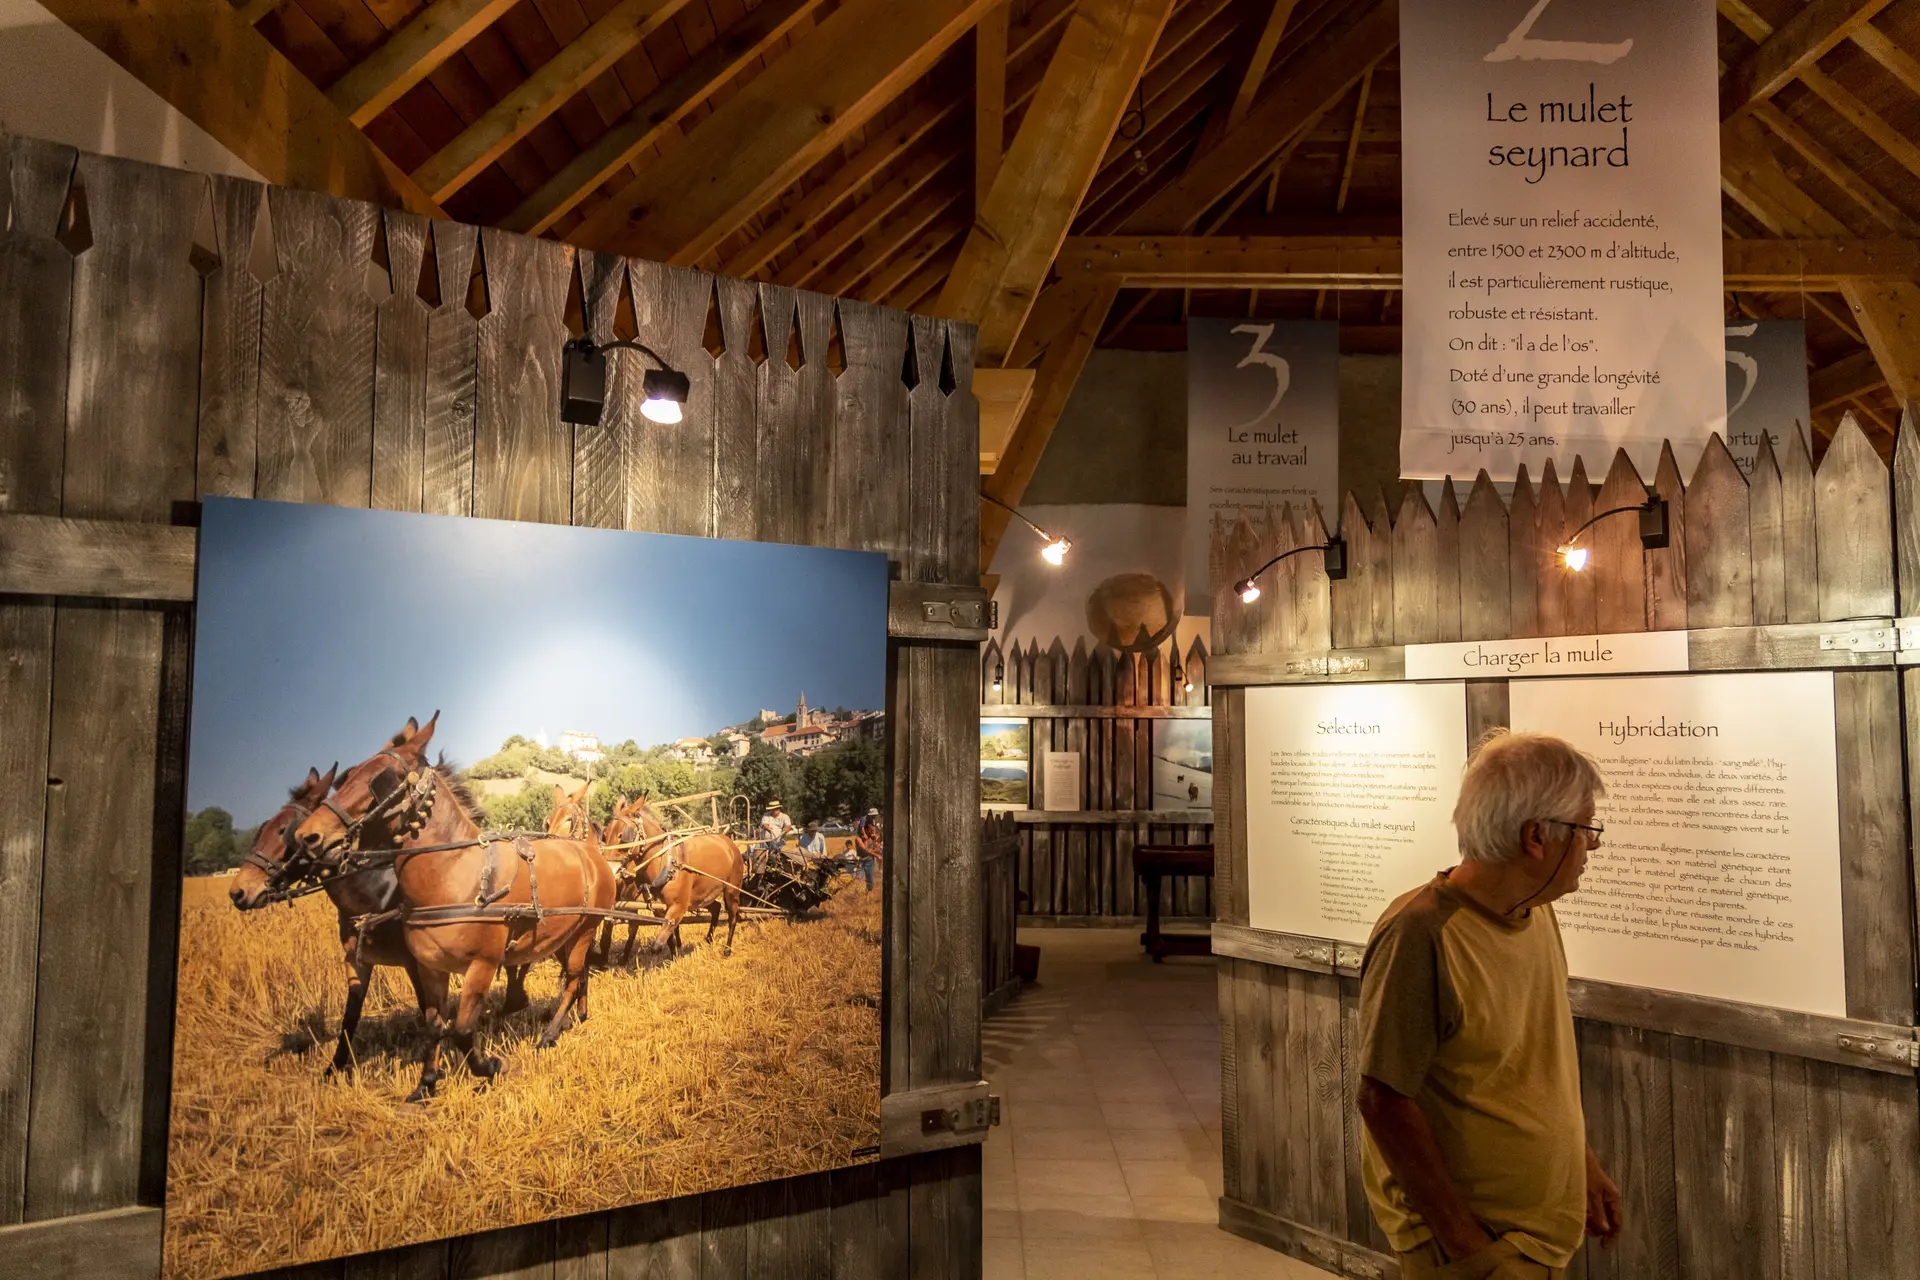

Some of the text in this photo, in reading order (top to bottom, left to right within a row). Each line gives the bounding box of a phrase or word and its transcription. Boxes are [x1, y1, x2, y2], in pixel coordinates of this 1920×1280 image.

[1487, 83, 1633, 123] Le mulet
[1488, 127, 1629, 184] seynard
[1448, 209, 1659, 230] Elevé sur un relief accidenté,
[1448, 245, 1487, 257] entre
[1491, 244, 1524, 258] 1500
[1529, 247, 1543, 258] et
[1548, 245, 1586, 259] 2300
[1591, 248, 1602, 258] m
[1448, 270, 1673, 297] il est particulièrement rustique,
[1448, 301, 1598, 321] robuste et résistant.
[1449, 337, 1473, 351] On
[1478, 333, 1498, 351] dit
[1527, 341, 1535, 350] a
[1540, 334, 1558, 352] de
[1230, 323, 1290, 429] 3
[1450, 365, 1661, 389] Doté d'une grande longévité
[1452, 399, 1476, 416] (30
[1523, 396, 1529, 414] il
[1534, 402, 1568, 422] peut
[1572, 397, 1636, 415] travailler
[1229, 424, 1299, 444] Le mulet
[1508, 432, 1524, 448] 25
[1529, 434, 1559, 446] ans.
[1232, 446, 1307, 466] au travail
[1463, 640, 1612, 672] Charger la mule
[1317, 717, 1380, 735] Sélection
[1599, 716, 1719, 745] Hybridation
[1664, 755, 1673, 765] du
[1675, 756, 1690, 765] latin
[1637, 768, 1787, 781] de deux de deux de
[1613, 780, 1621, 788] de
[1623, 780, 1640, 788] deux
[1684, 782, 1694, 790] de
[1696, 782, 1715, 791] deux
[1716, 786, 1742, 794] genres
[1687, 794, 1700, 803] elle
[1720, 796, 1738, 805] alors
[1620, 803, 1629, 812] les
[1666, 810, 1700, 818] sauvages
[1751, 809, 1771, 820] dans
[1773, 811, 1789, 820] des
[1290, 816, 1415, 834] Caractéristiques du mulet seynard
[1619, 817, 1631, 825] sud
[1702, 824, 1737, 833] sauvages
[1740, 824, 1763, 832] vivent
[1782, 825, 1789, 834] le
[1608, 840, 1617, 848] de
[1696, 848, 1731, 858] présente
[1733, 848, 1744, 857] les
[1591, 851, 1604, 859] des
[1608, 853, 1626, 861] deux
[1768, 866, 1791, 874] étant
[1596, 875, 1645, 887] chromosomes
[1649, 883, 1660, 892] qui
[1618, 868, 1630, 876] par
[1635, 866, 1641, 874] le
[1724, 874, 1734, 883] de
[1740, 875, 1770, 886] chacun
[1775, 878, 1791, 888] des
[1646, 892, 1663, 901] chez
[1666, 892, 1694, 905] chacun
[1696, 897, 1711, 906] des
[1583, 912, 1609, 920] surtout
[1611, 913, 1620, 922] de
[1622, 914, 1628, 923] la
[1662, 918, 1669, 927] le
[1671, 920, 1687, 932] plus
[1726, 926, 1737, 935] de
[1755, 928, 1793, 942] hybrides
[1726, 915, 1760, 925] moindre
[1763, 917, 1774, 927] de
[1574, 922, 1606, 933] quelques
[1622, 926, 1631, 935] de
[1633, 929, 1668, 940] gestation
[1701, 939, 1714, 948] par
[1717, 938, 1732, 947] des
